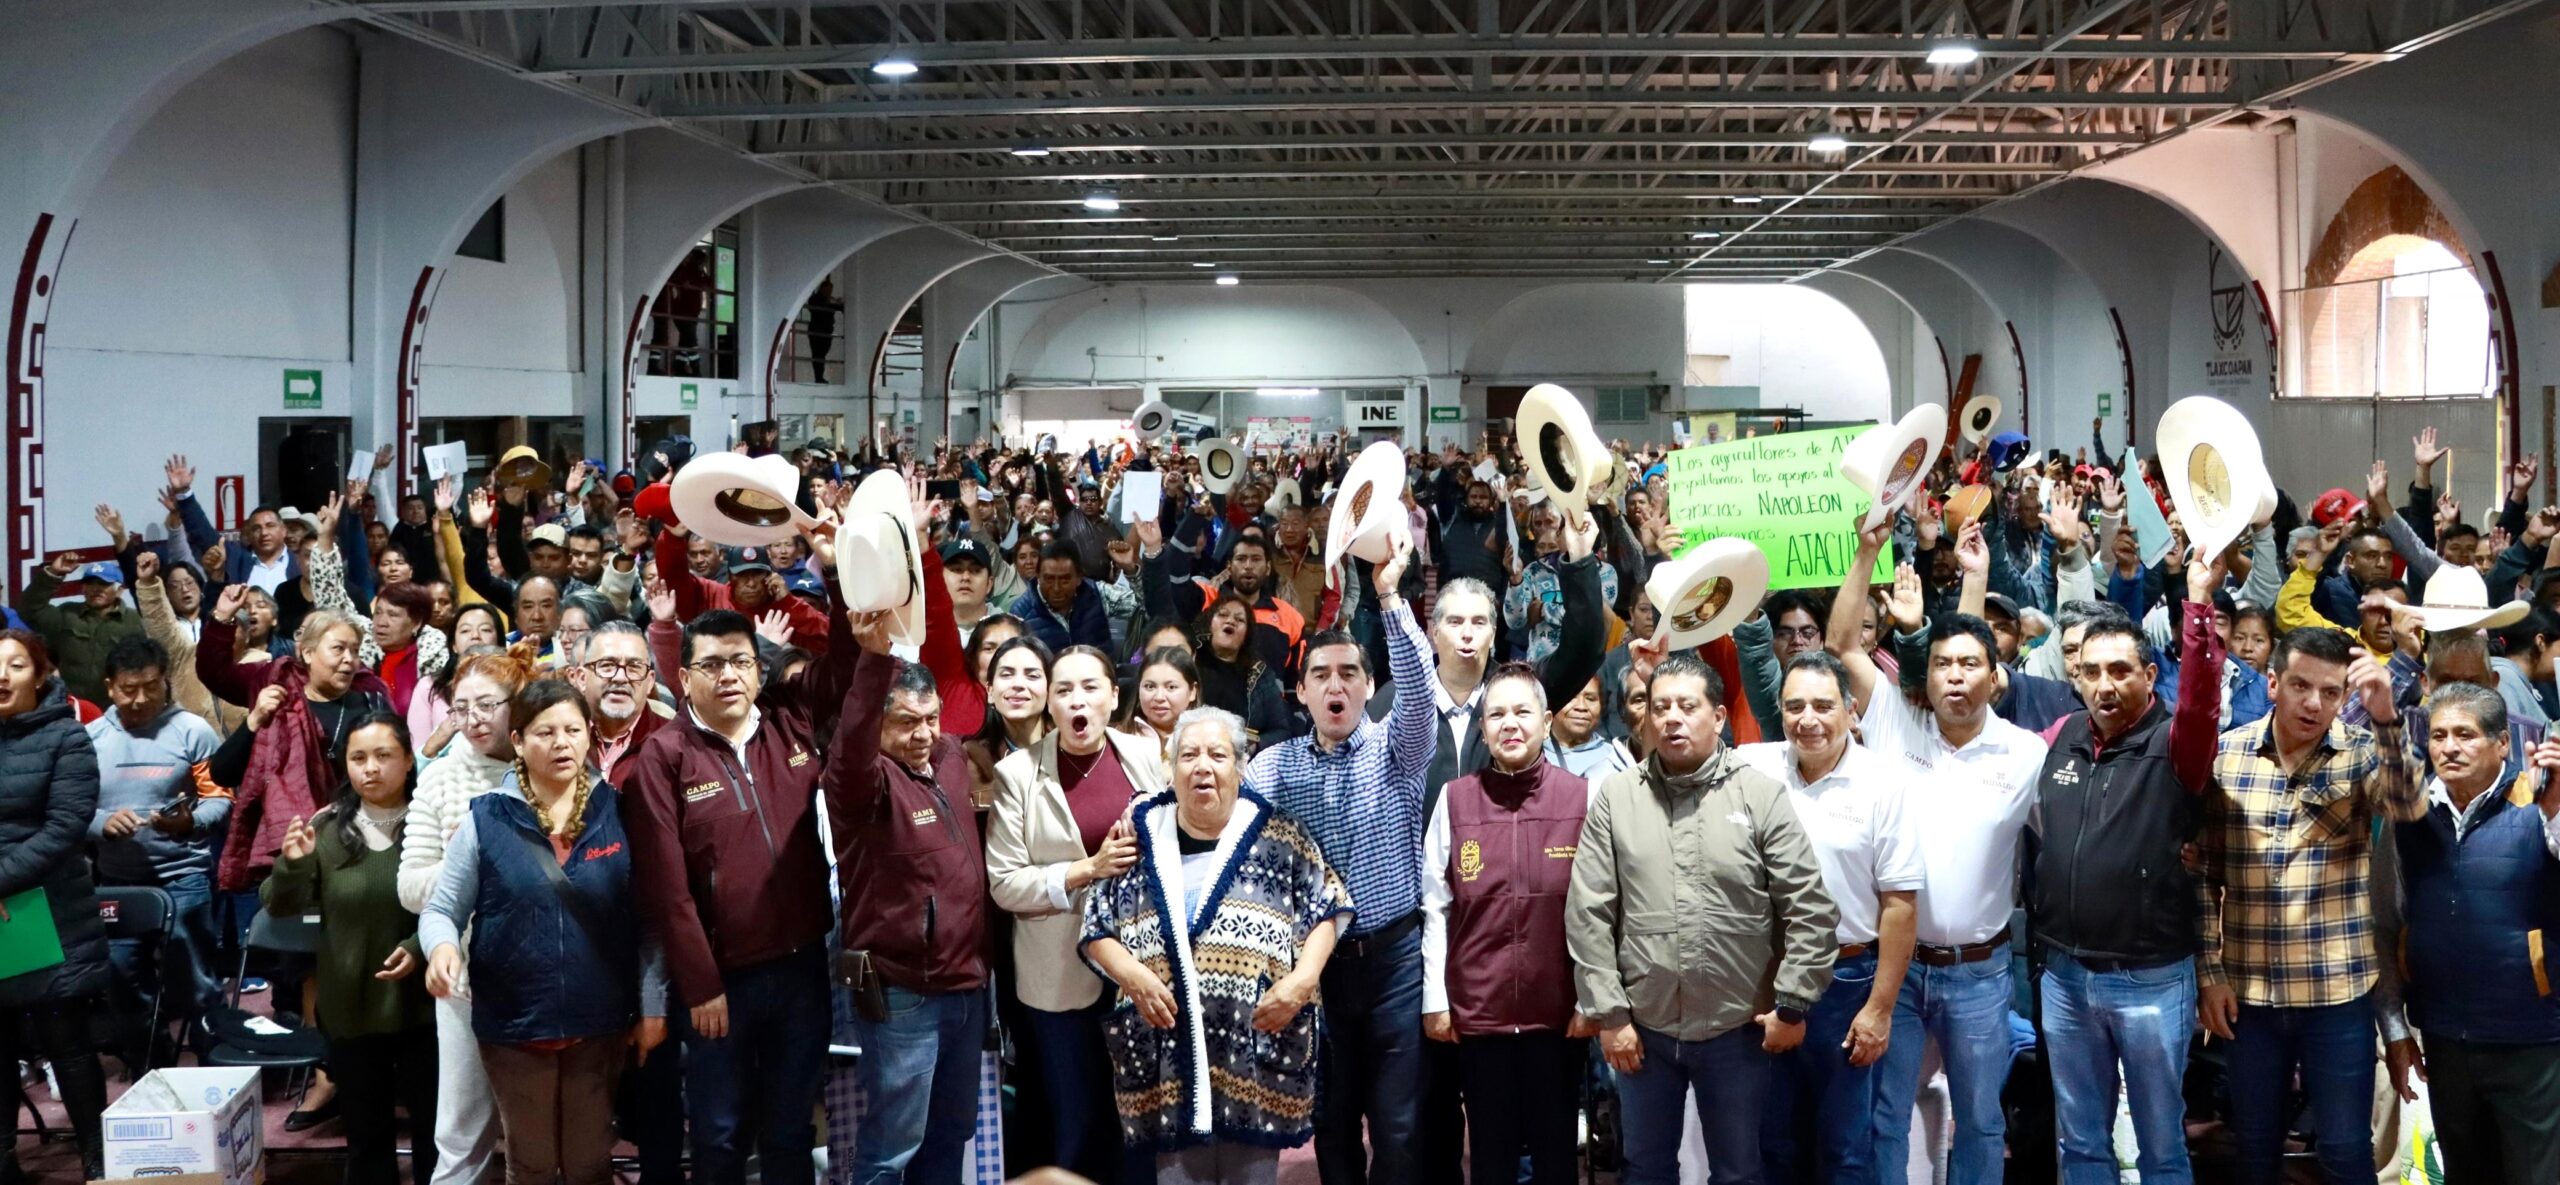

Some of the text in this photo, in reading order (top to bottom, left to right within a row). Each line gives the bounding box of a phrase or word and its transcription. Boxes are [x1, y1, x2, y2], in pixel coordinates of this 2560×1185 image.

[2206, 360, 2252, 376] TLAXCOAPAN
[1361, 406, 1397, 420] INE
[1676, 456, 1703, 472] Los
[1711, 441, 1796, 472] agricultores
[1806, 441, 1822, 455] de
[1752, 468, 1772, 484] los
[1822, 462, 1833, 479] al
[1758, 489, 1842, 516] NAPOLEON
[1904, 751, 1933, 769] CAMPO
[687, 781, 720, 795] CAMPO
[1982, 779, 2017, 791] HIDALGO
